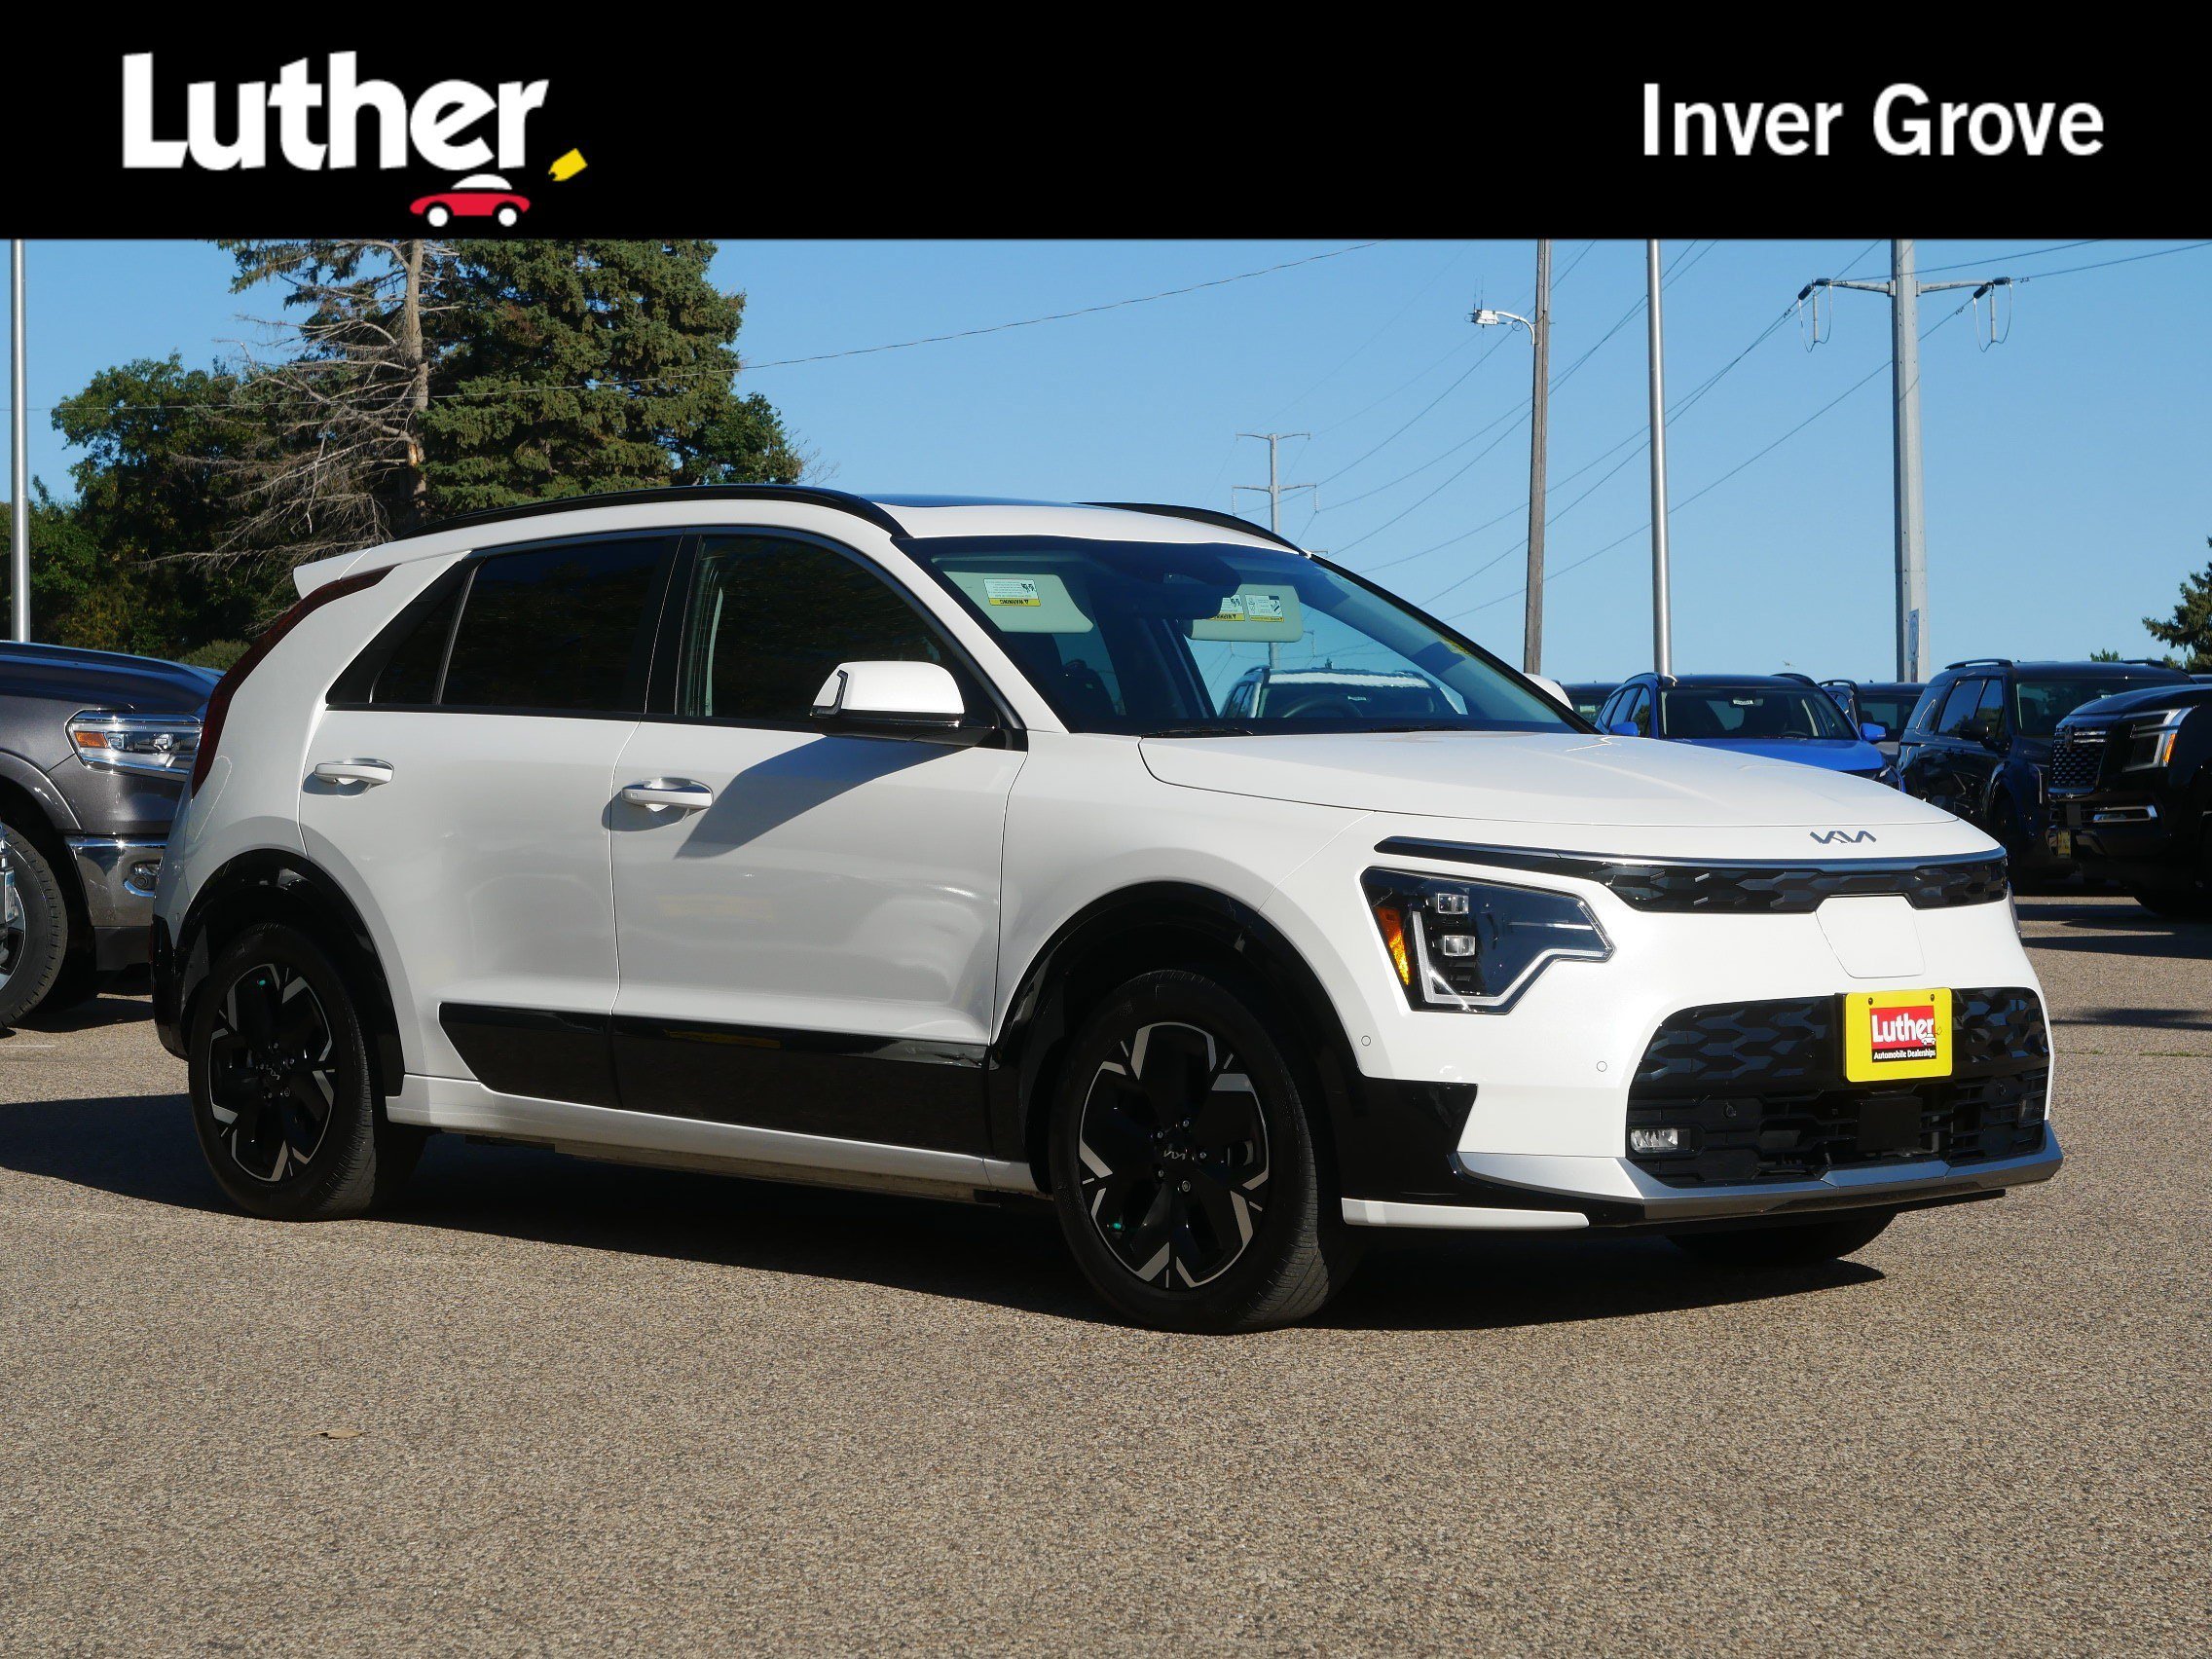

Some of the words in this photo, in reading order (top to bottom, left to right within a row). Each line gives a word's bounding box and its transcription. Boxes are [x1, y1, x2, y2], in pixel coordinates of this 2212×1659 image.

[1871, 1013, 1935, 1043] Luther
[1873, 1051, 1907, 1060] Automobile
[1907, 1049, 1936, 1059] Dealerships
